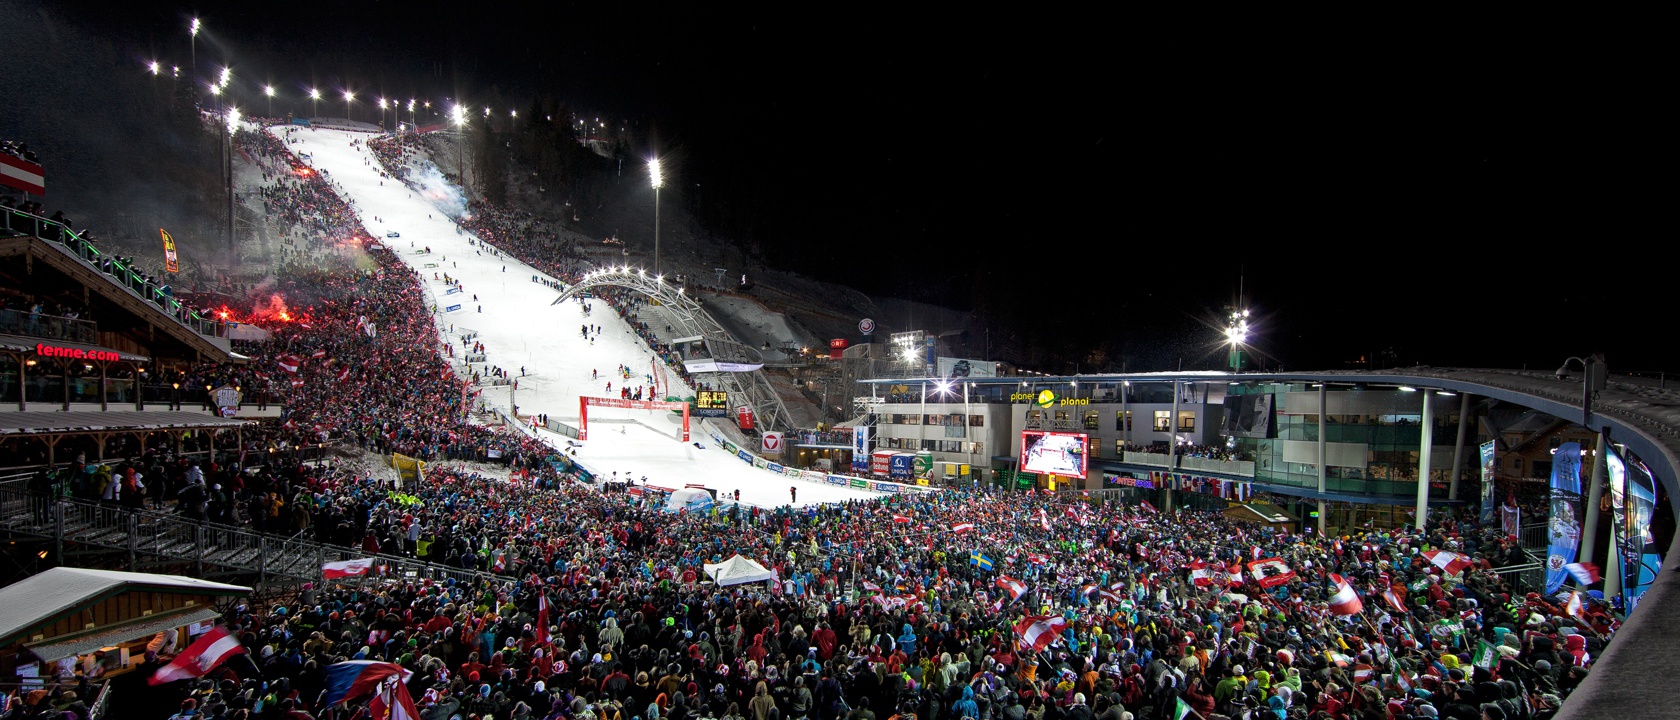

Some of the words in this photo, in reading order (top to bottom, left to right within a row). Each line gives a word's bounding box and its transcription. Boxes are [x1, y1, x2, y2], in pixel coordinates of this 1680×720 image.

[36, 342, 119, 361] tenne.com
[1010, 391, 1035, 402] planet
[1060, 396, 1089, 407] planai
[883, 484, 898, 492] UNIQA
